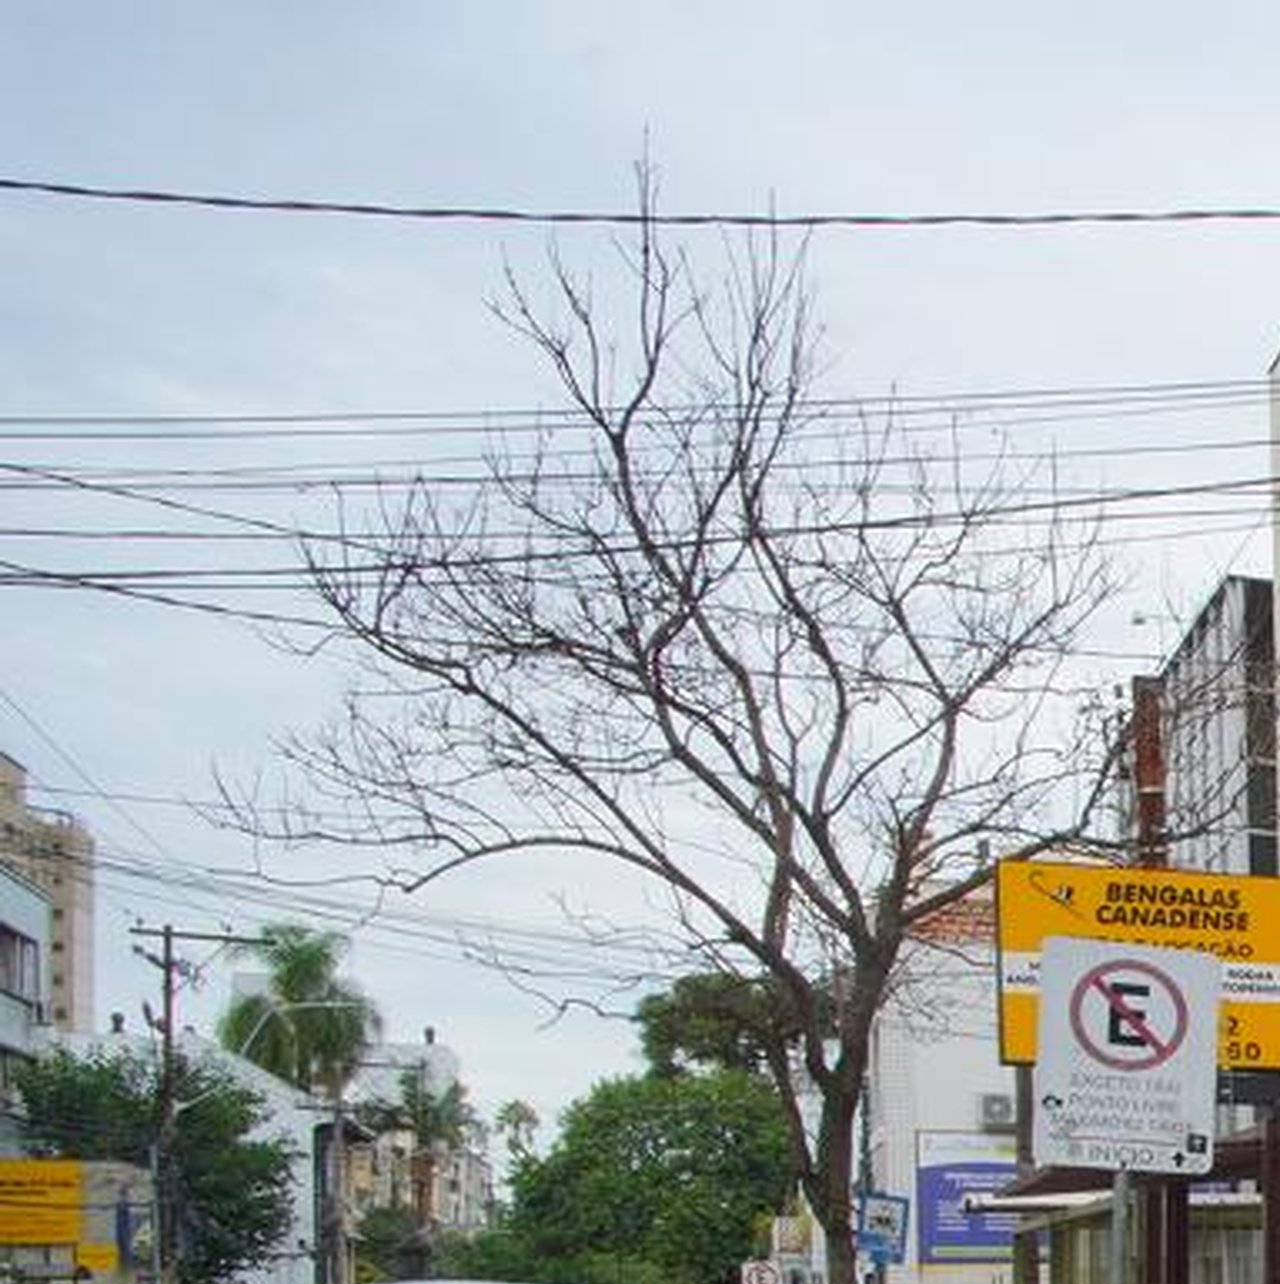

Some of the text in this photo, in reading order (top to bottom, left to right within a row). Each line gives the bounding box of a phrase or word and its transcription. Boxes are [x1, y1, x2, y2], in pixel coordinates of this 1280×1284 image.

[1105, 882, 1241, 910] BENGALAS
[1095, 905, 1249, 932] CANADENSE
[1108, 982, 1150, 1047] E
